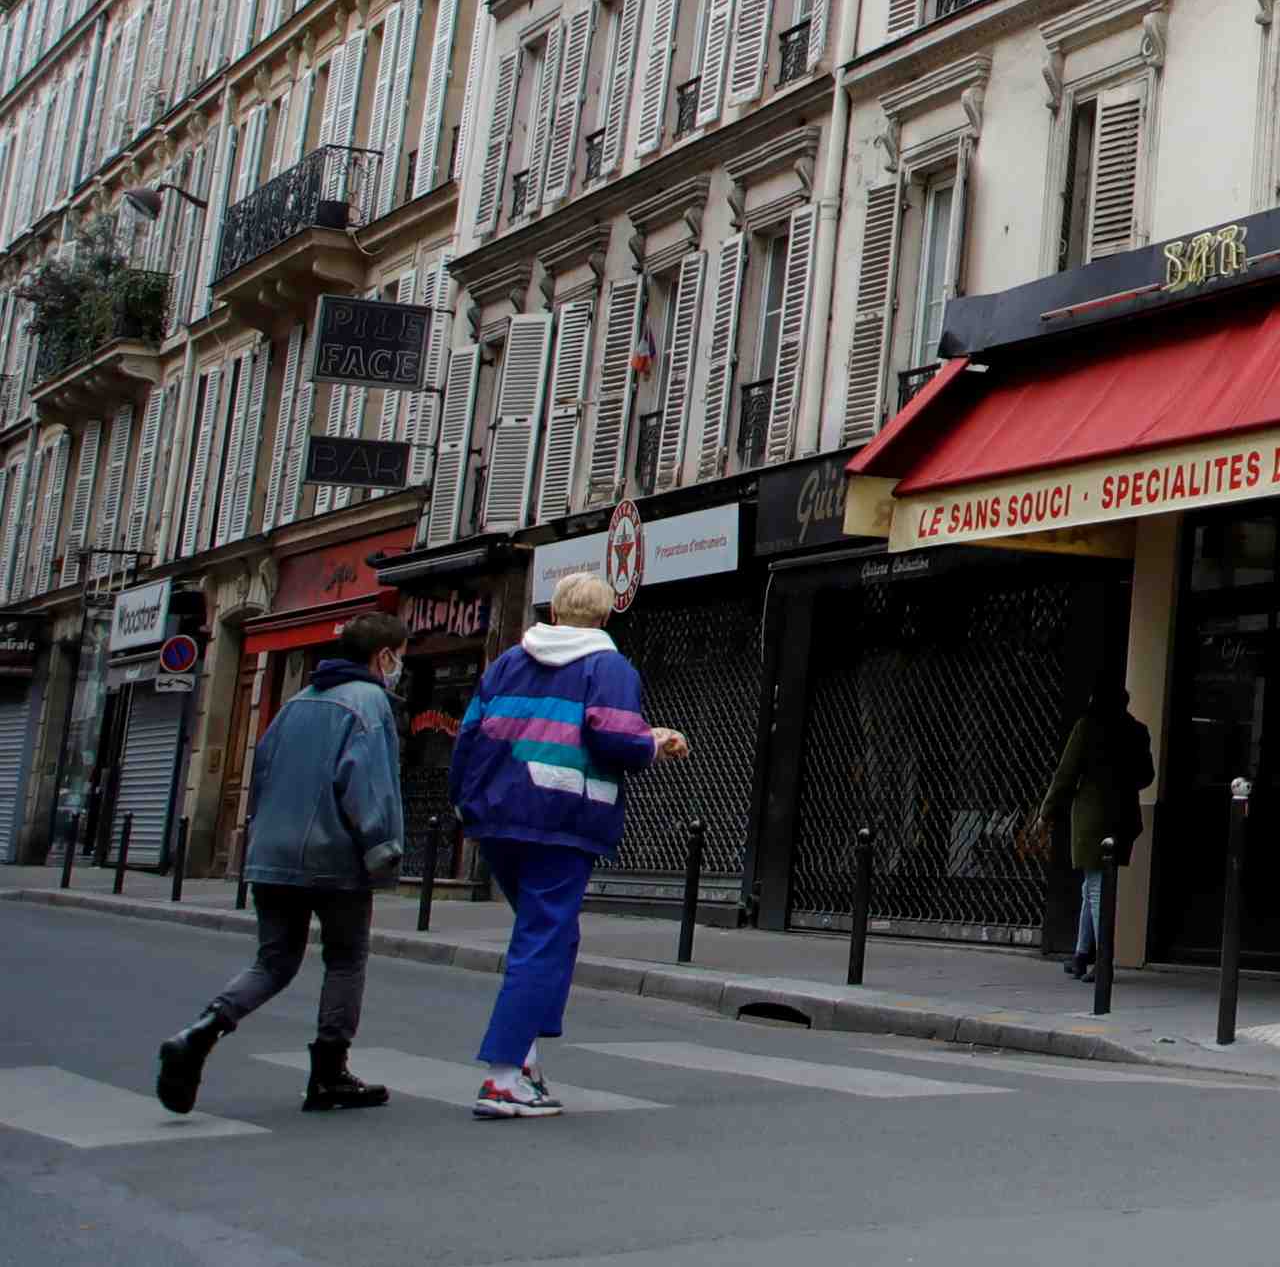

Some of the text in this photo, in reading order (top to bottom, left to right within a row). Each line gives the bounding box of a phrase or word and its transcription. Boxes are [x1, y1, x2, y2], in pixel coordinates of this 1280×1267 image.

[319, 342, 420, 382] FACE
[311, 444, 401, 480] BAR
[917, 505, 945, 539] LE
[948, 495, 1002, 534] SANS
[1006, 483, 1073, 527] SOUCI
[1101, 452, 1261, 511] SPECIALITES
